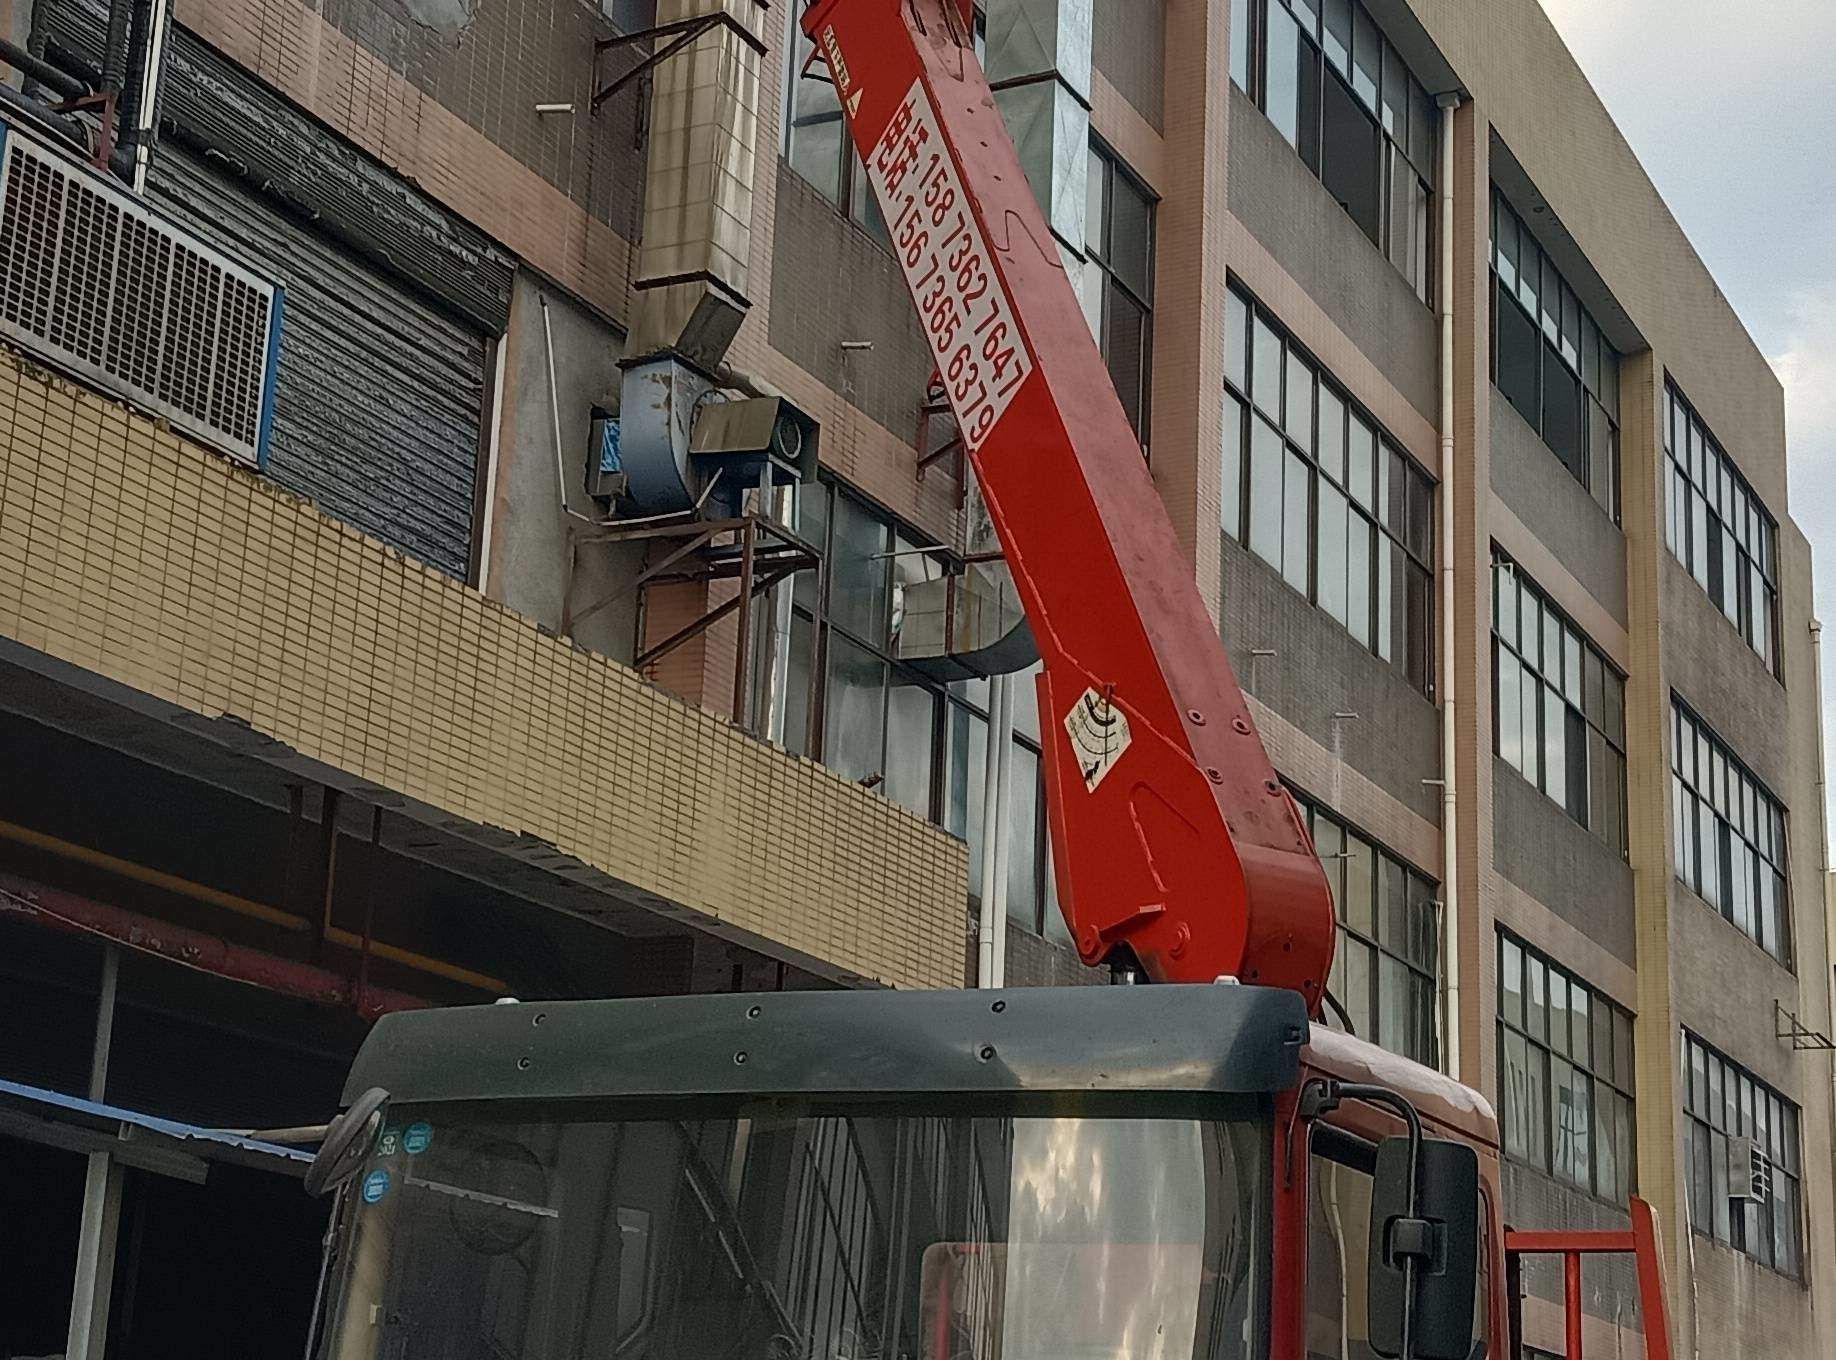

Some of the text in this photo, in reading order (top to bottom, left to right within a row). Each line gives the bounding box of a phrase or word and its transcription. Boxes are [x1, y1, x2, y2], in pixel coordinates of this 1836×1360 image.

[893, 194, 995, 444] 156 7365 6379
[918, 153, 955, 228] 158
[941, 211, 988, 316] 7362
[974, 297, 1024, 398] 7647
